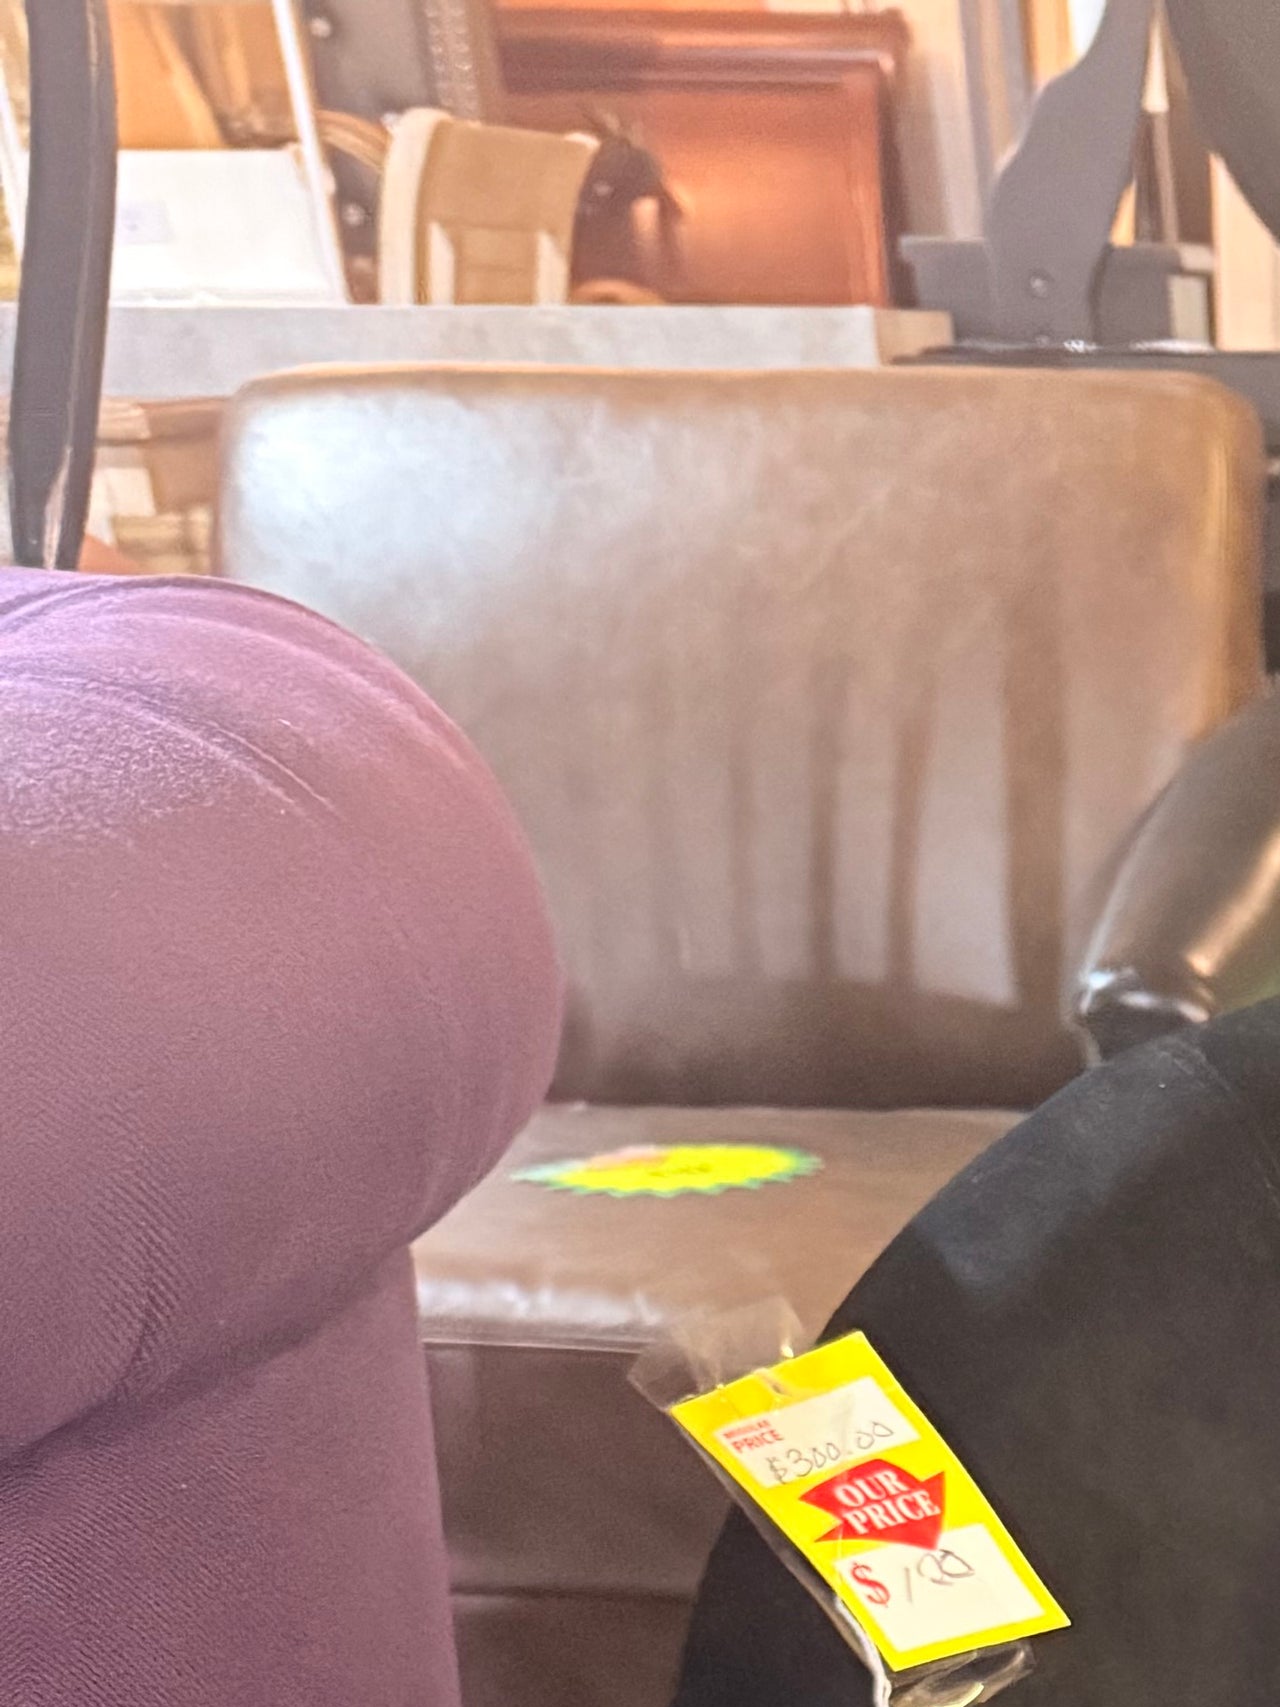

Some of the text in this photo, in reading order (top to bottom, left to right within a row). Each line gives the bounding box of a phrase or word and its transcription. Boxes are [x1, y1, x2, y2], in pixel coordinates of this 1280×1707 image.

[732, 1430, 784, 1453] PRICE
[834, 1470, 909, 1508] OUR
[842, 1490, 941, 1535] PRICE
